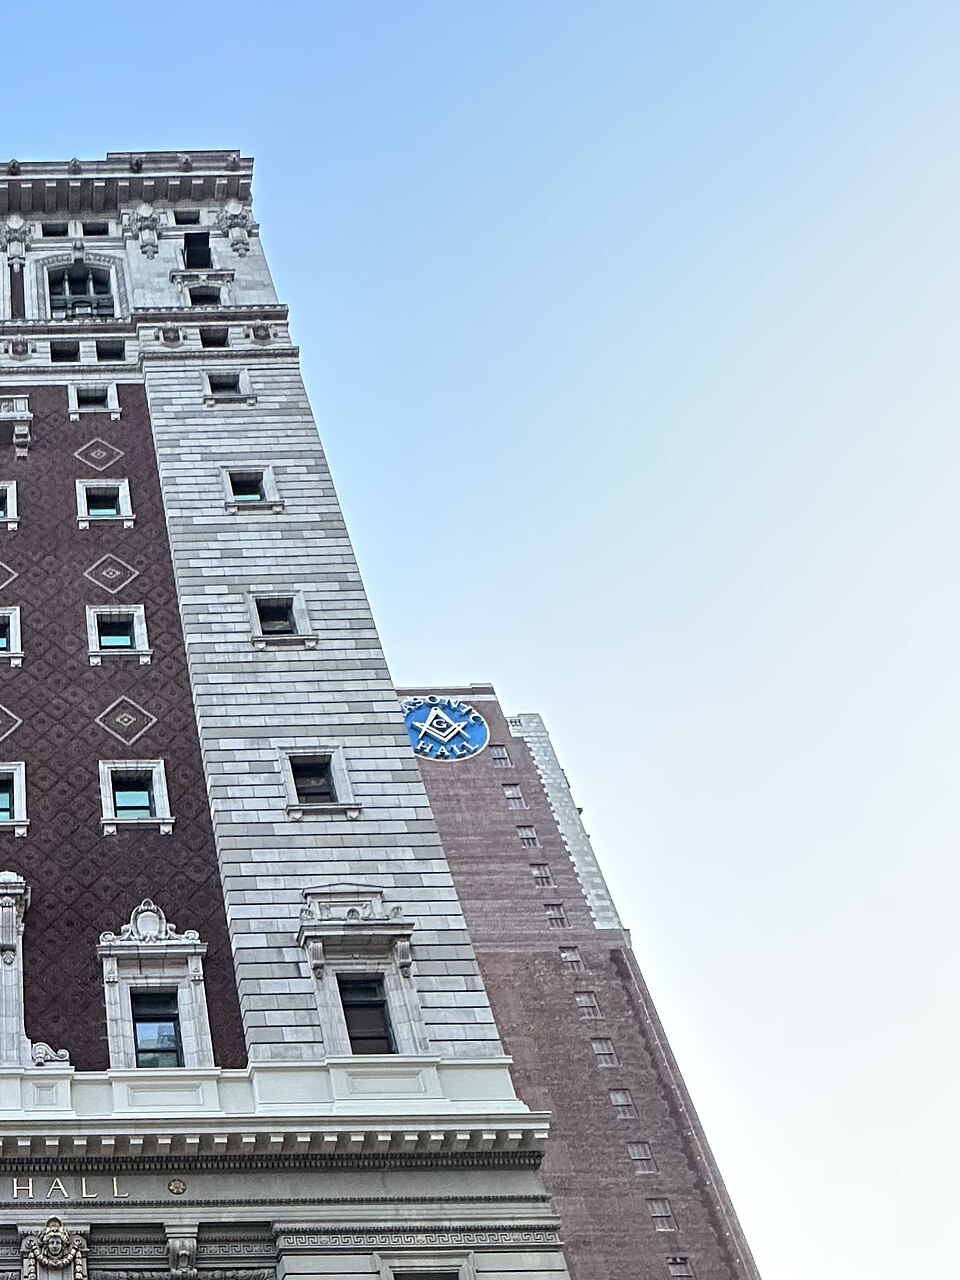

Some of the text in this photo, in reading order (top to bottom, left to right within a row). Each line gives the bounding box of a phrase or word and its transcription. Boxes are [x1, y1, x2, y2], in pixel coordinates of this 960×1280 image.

[402, 694, 485, 725] ASONIC
[432, 718, 448, 729] G
[416, 740, 479, 757] HALL
[12, 1177, 129, 1199] HALL
